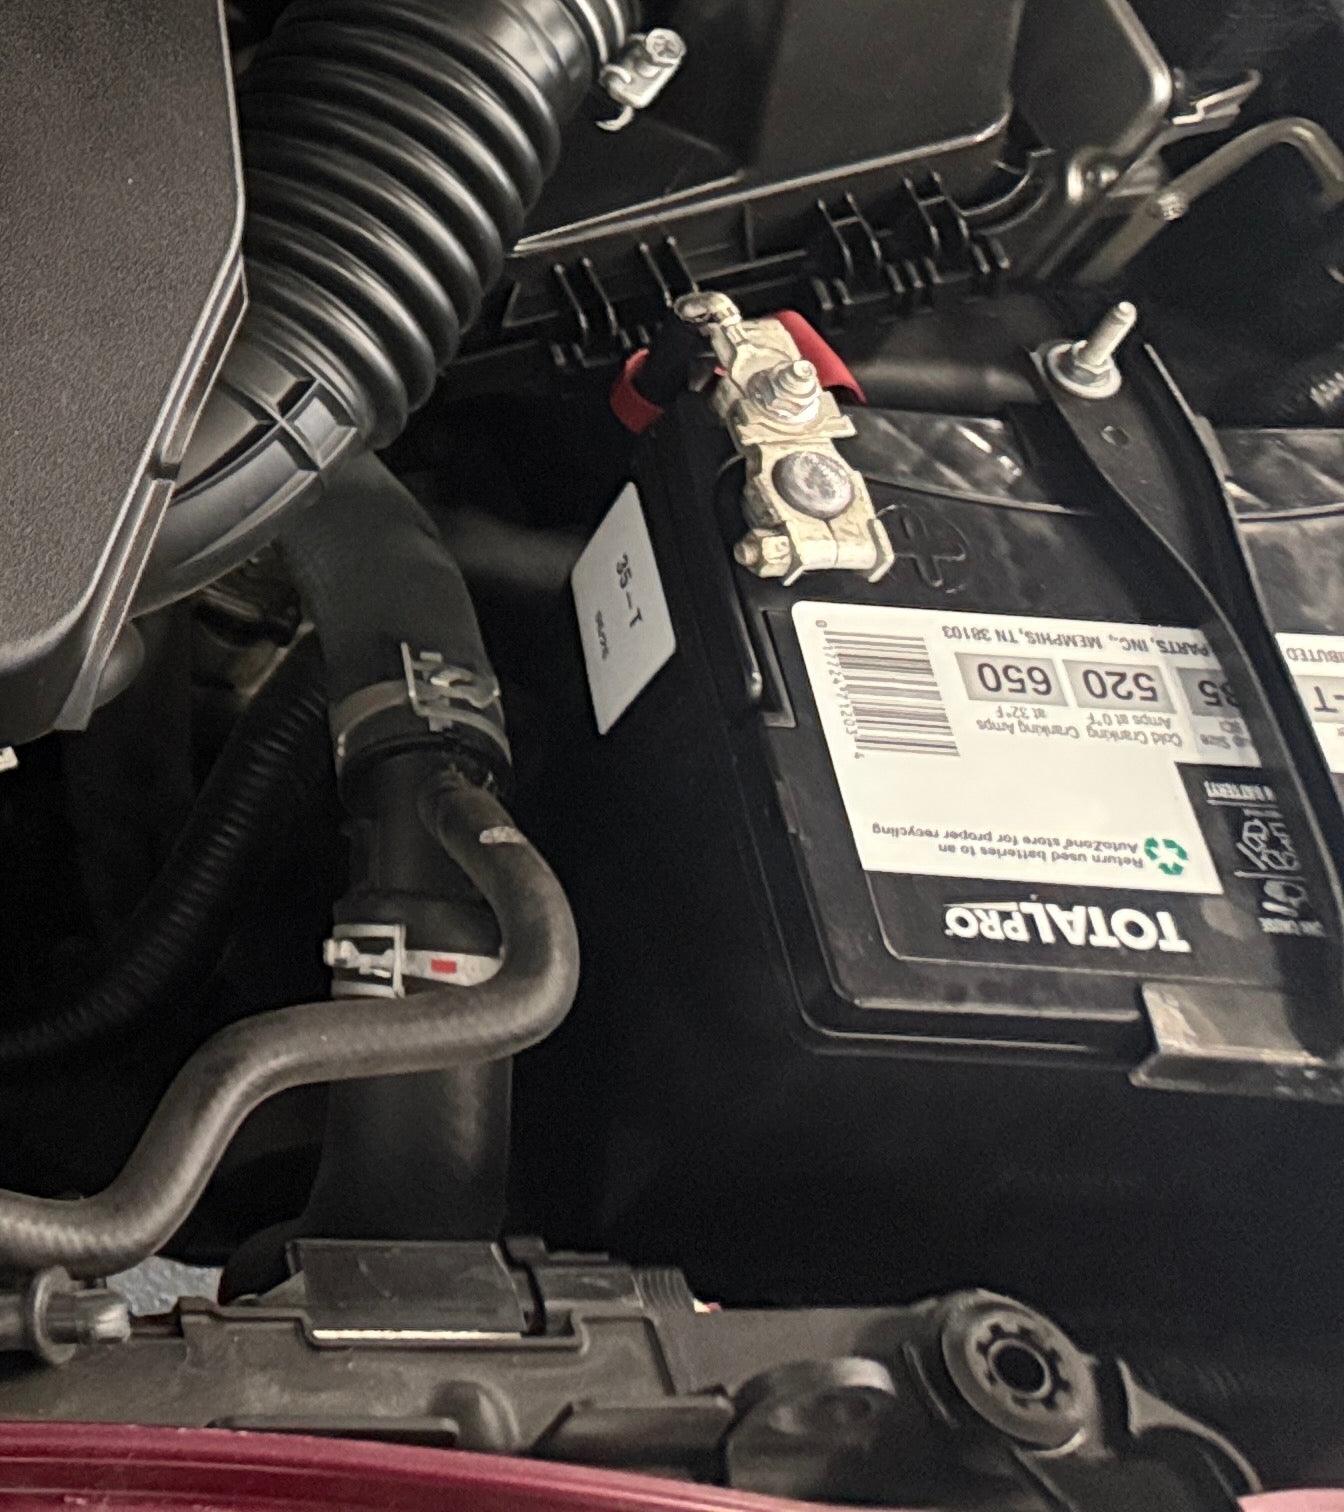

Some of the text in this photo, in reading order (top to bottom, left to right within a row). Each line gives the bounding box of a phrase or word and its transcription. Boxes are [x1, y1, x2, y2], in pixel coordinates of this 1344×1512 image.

[815, 619, 828, 628] 0
[942, 625, 991, 641] 38103
[994, 628, 1016, 643] TN
[1019, 627, 1103, 650] MEMPHIS,
[1150, 638, 1211, 657] PARTS,
[977, 662, 1053, 696] 650
[1082, 669, 1159, 702] 520
[1032, 708, 1047, 719] at
[1133, 715, 1172, 730] Amps
[976, 718, 1079, 739] Cranking Amps
[1086, 727, 1184, 747] Cold Cranking
[871, 821, 940, 839] recycling
[943, 830, 993, 844] proper
[995, 833, 1019, 847] for
[1021, 835, 1061, 848] store
[938, 843, 1145, 869] Return used batteries to an
[944, 901, 1193, 954] TOTALPRO
